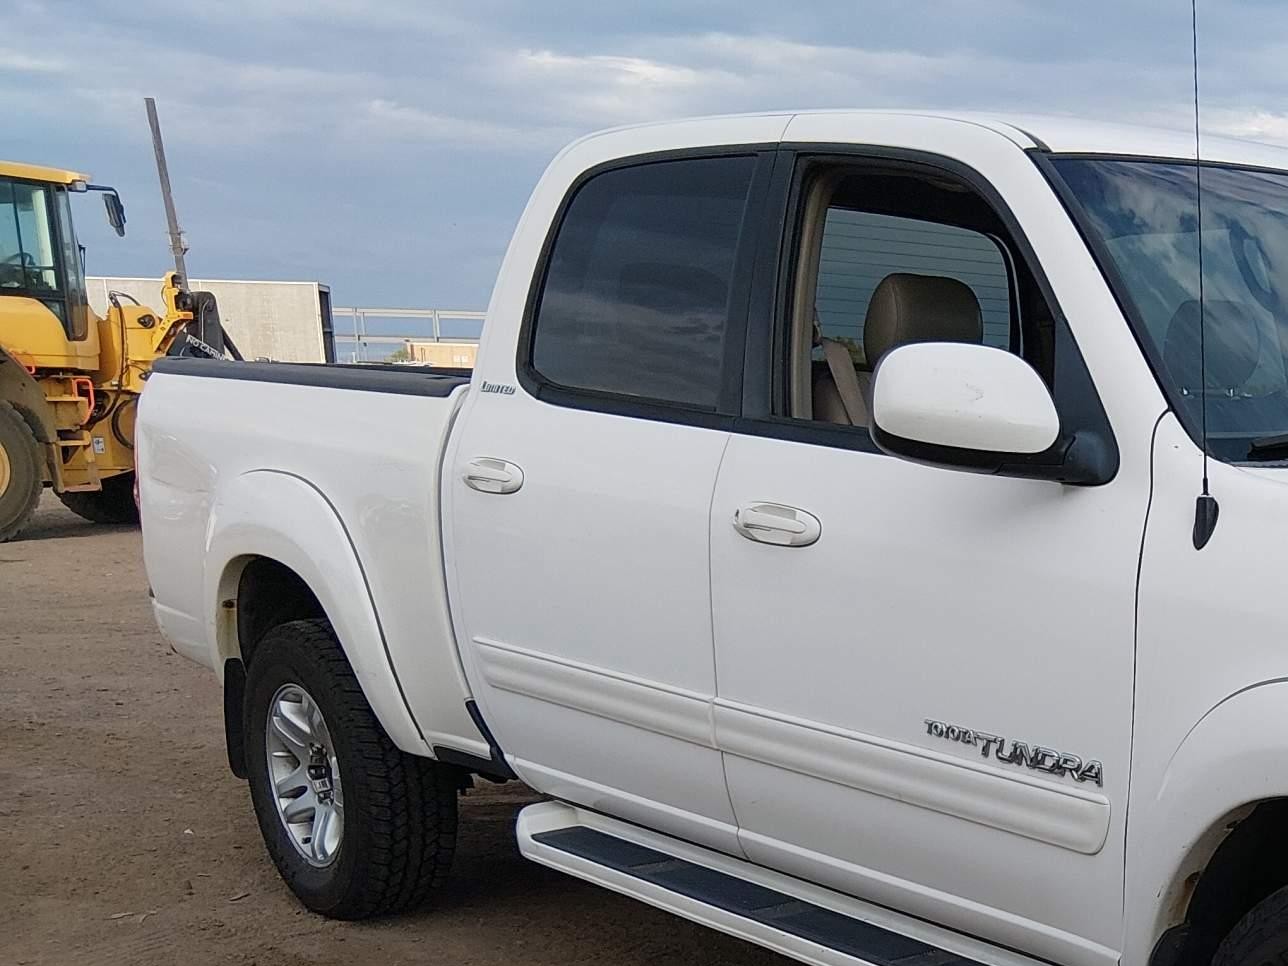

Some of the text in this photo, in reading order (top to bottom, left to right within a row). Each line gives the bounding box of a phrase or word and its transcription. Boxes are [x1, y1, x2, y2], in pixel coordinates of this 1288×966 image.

[186, 334, 200, 347] NO
[924, 719, 1104, 788] TOYOTA TUNDRA
